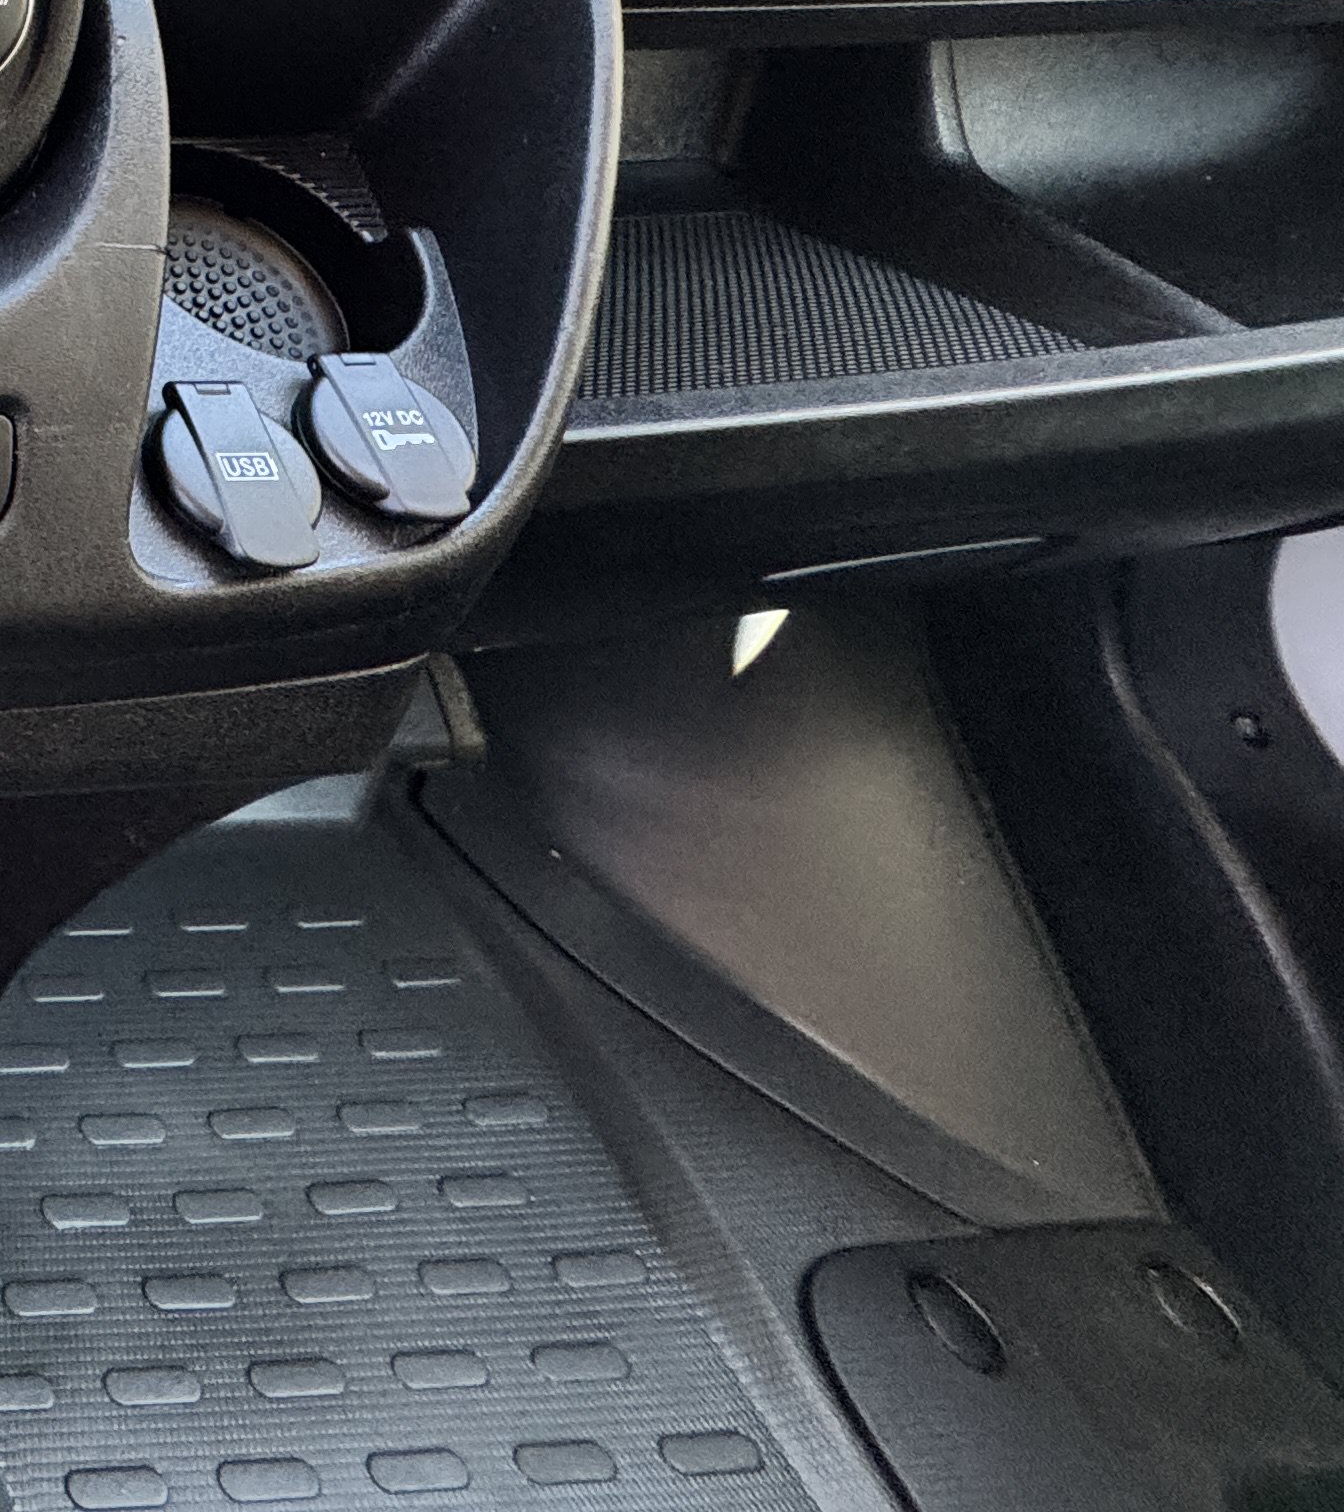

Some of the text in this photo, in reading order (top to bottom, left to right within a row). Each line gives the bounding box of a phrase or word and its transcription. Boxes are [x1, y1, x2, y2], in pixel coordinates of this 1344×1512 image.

[362, 409, 424, 428] 12V DC
[223, 456, 270, 477] USB
